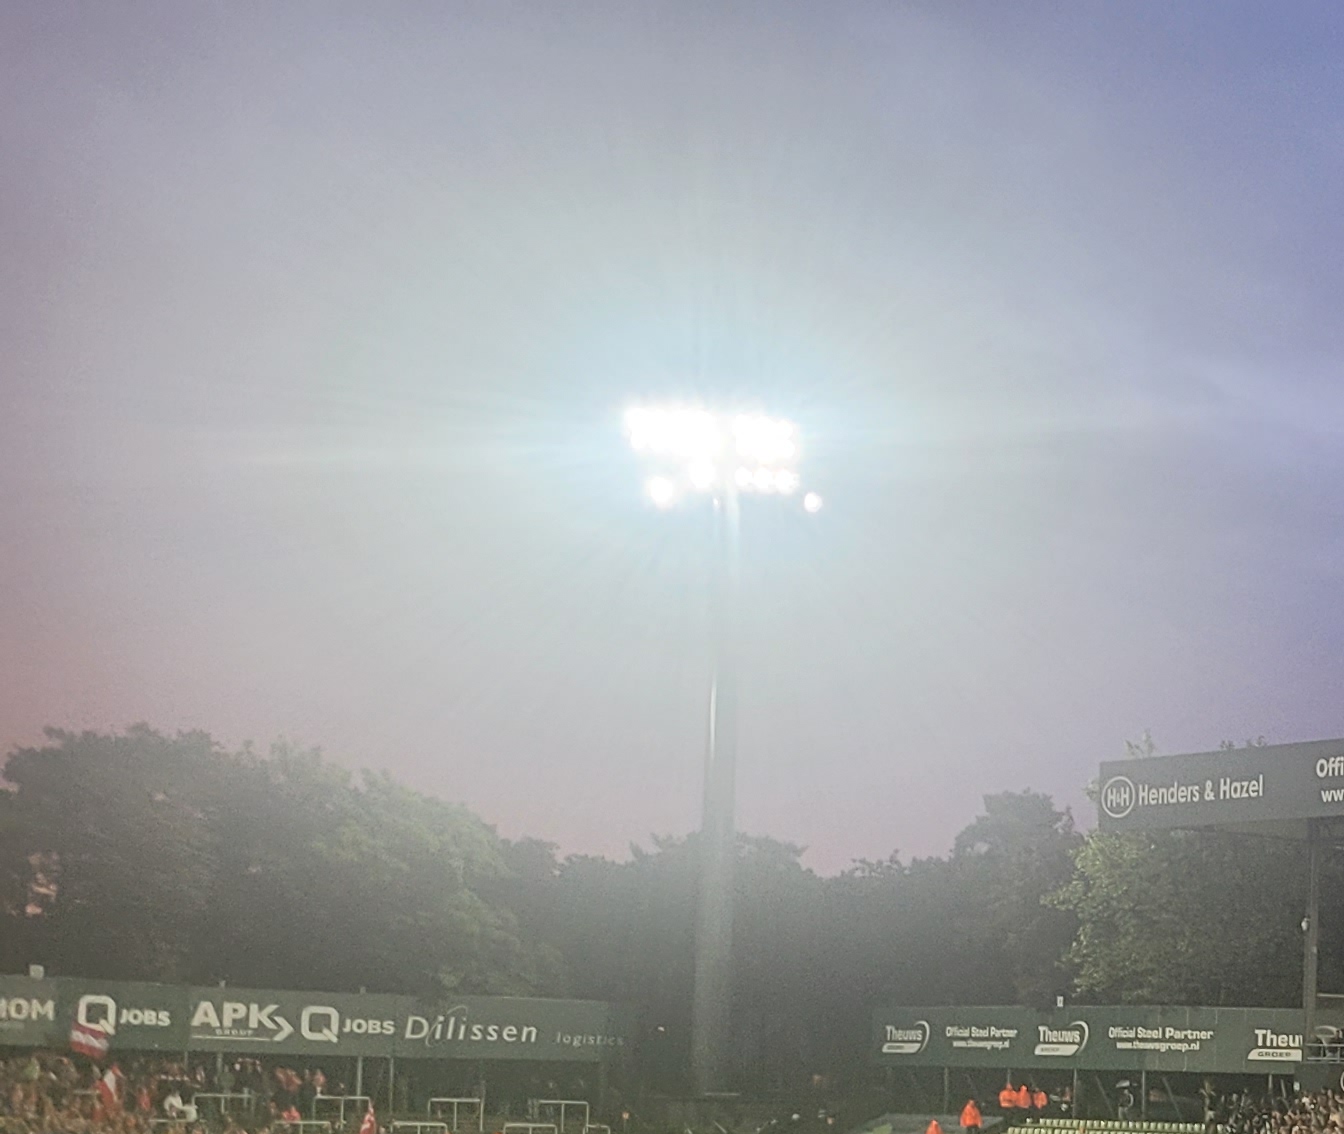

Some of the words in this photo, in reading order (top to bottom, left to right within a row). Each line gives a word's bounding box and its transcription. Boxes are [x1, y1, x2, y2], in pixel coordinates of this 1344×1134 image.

[1107, 786, 1130, 808] H&H
[1138, 781, 1200, 806] Henders
[1204, 780, 1215, 801] &
[1220, 774, 1264, 799] Hazel
[120, 1009, 171, 1027] JOBS
[191, 1000, 284, 1030] APK
[342, 1018, 396, 1035] JOBS
[404, 1014, 538, 1043] Dilissen
[1038, 1025, 1081, 1043] Theuws
[1108, 1027, 1136, 1039] Official
[1165, 1027, 1214, 1040] Partner
